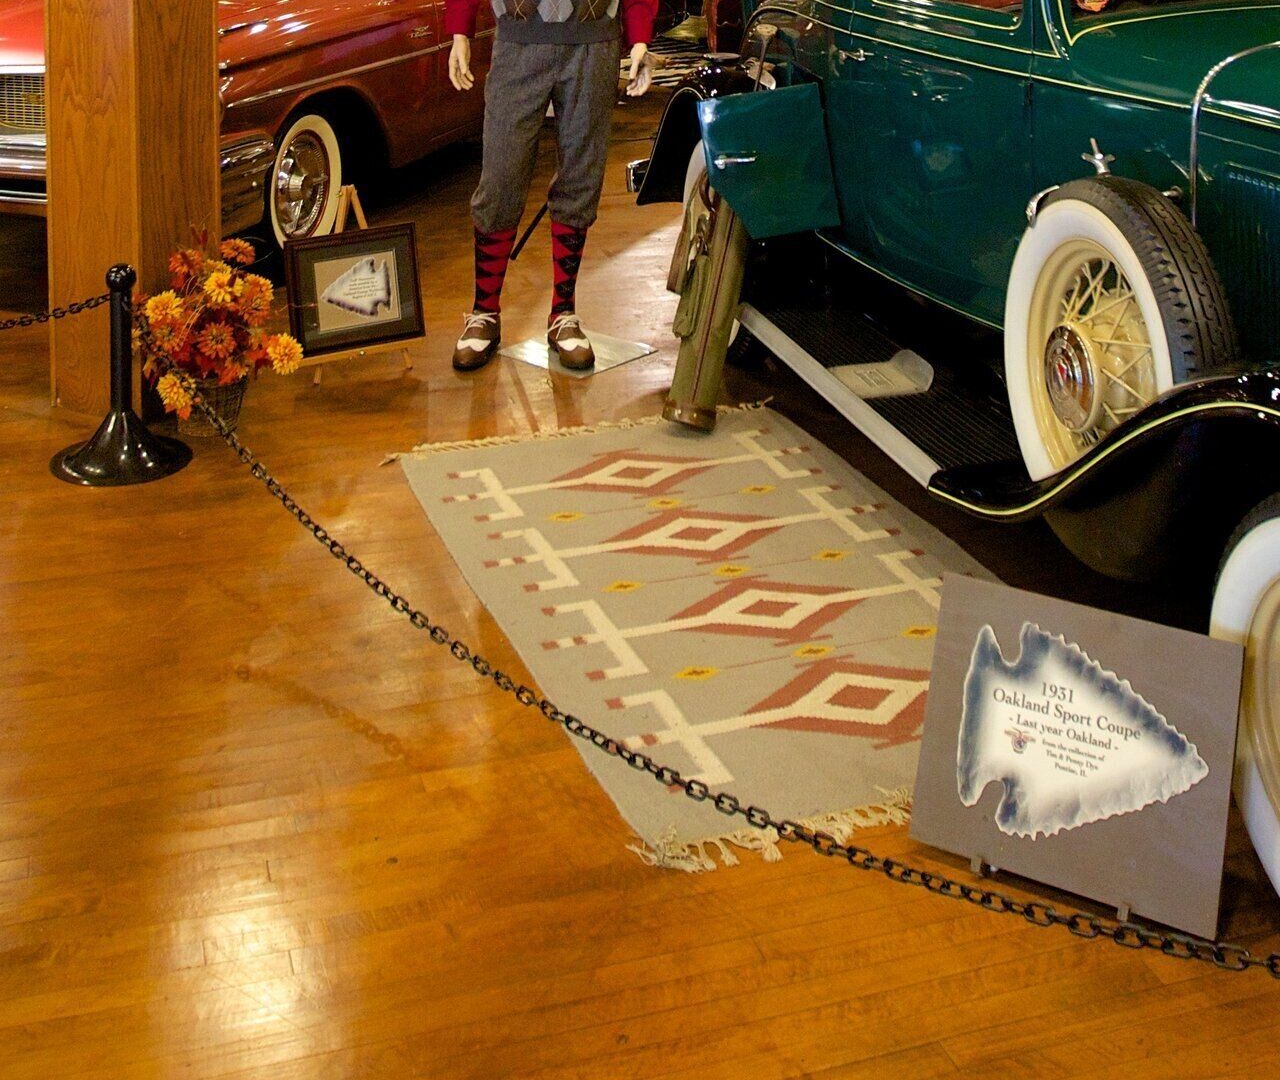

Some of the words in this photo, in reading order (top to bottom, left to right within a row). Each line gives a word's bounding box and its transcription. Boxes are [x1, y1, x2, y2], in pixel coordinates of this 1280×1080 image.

[1042, 682, 1074, 704] 1931
[993, 688, 1050, 715] Oakland
[1054, 704, 1092, 726] Sport
[1096, 716, 1141, 740] Coupe
[1017, 714, 1037, 730] Last
[1039, 724, 1063, 736] year
[1066, 728, 1112, 750] Oakland
